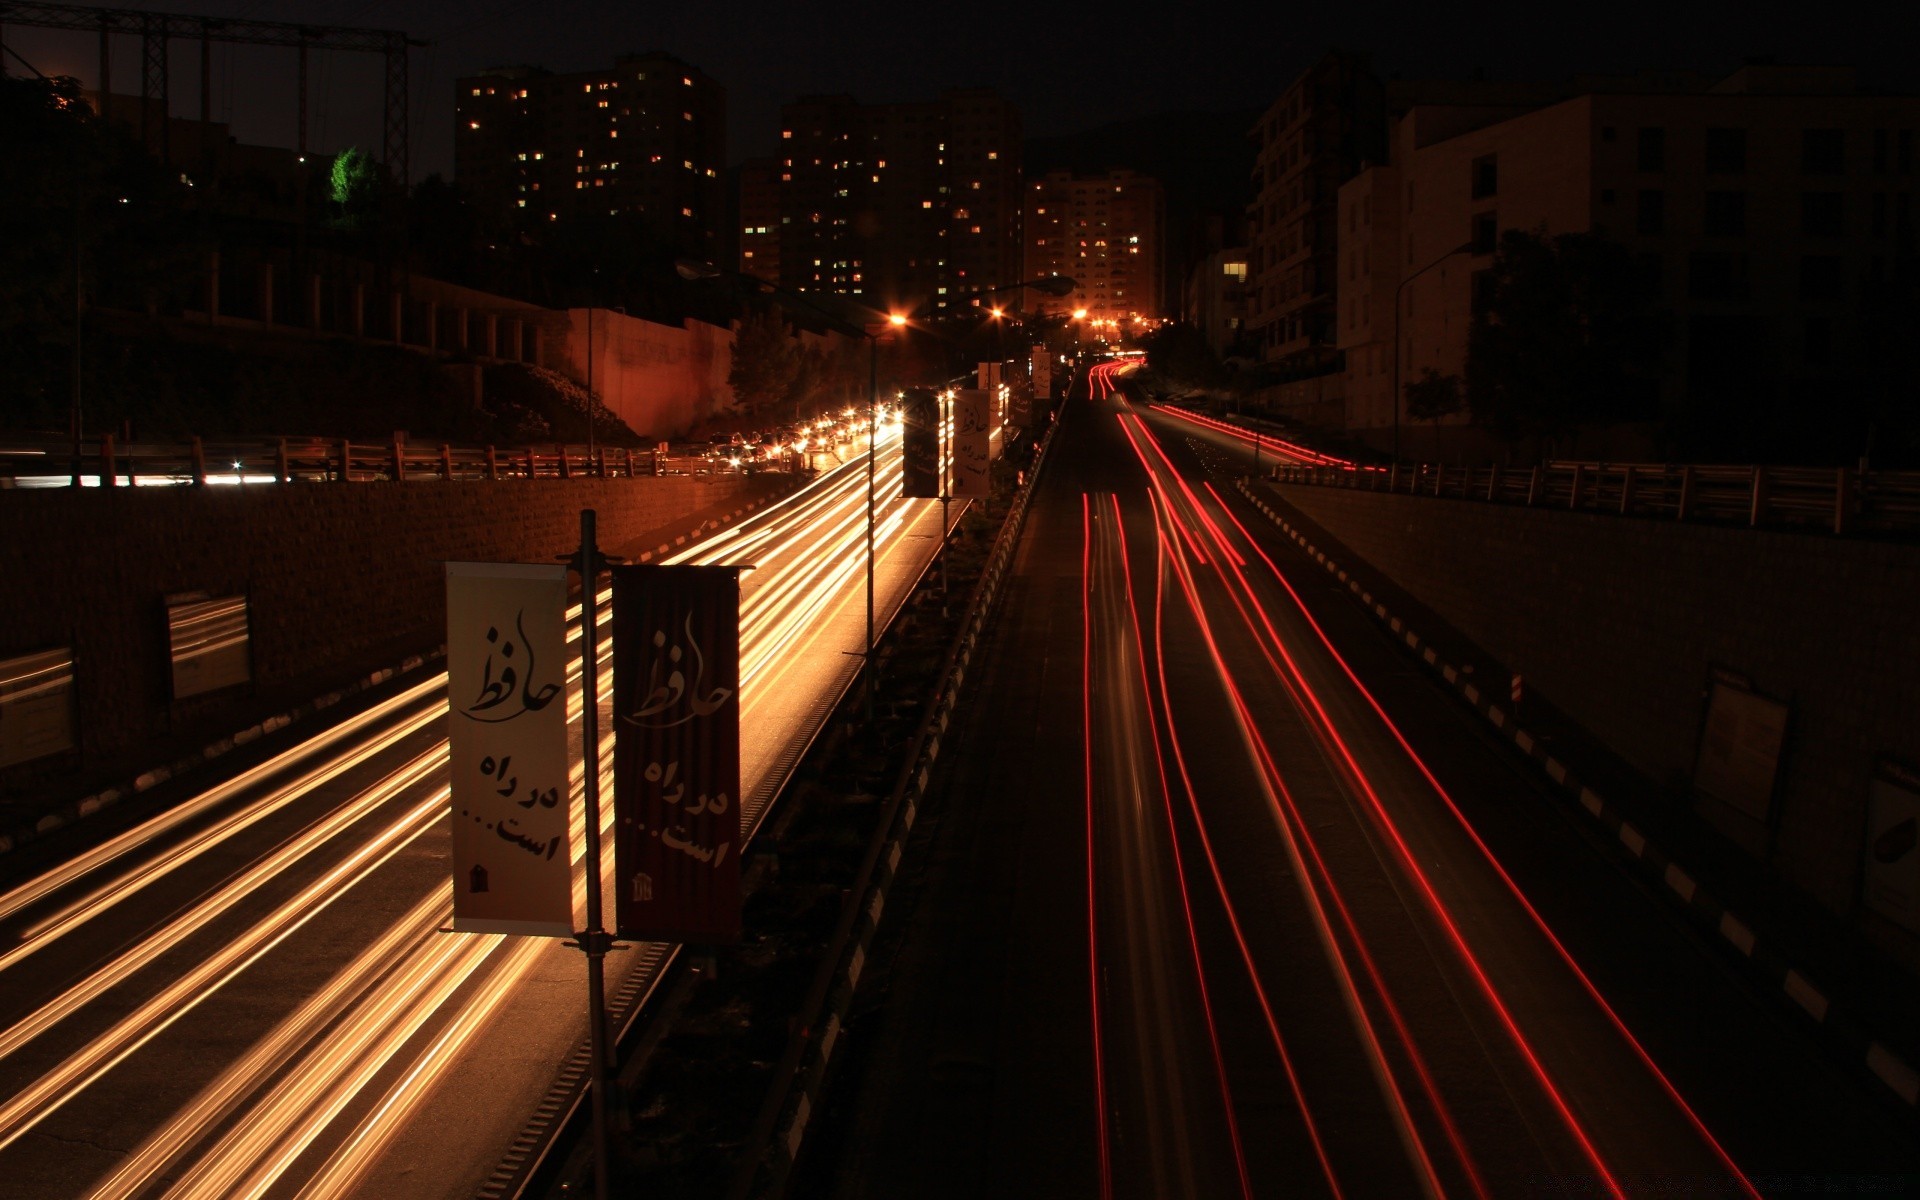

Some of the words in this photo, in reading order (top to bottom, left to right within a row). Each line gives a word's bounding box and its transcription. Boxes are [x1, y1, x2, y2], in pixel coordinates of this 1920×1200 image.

[458, 608, 562, 723] حافظ
[621, 610, 733, 729] حافظ
[480, 755, 518, 799] راه
[517, 786, 559, 809] در
[644, 761, 685, 805] راه
[685, 792, 728, 815] در
